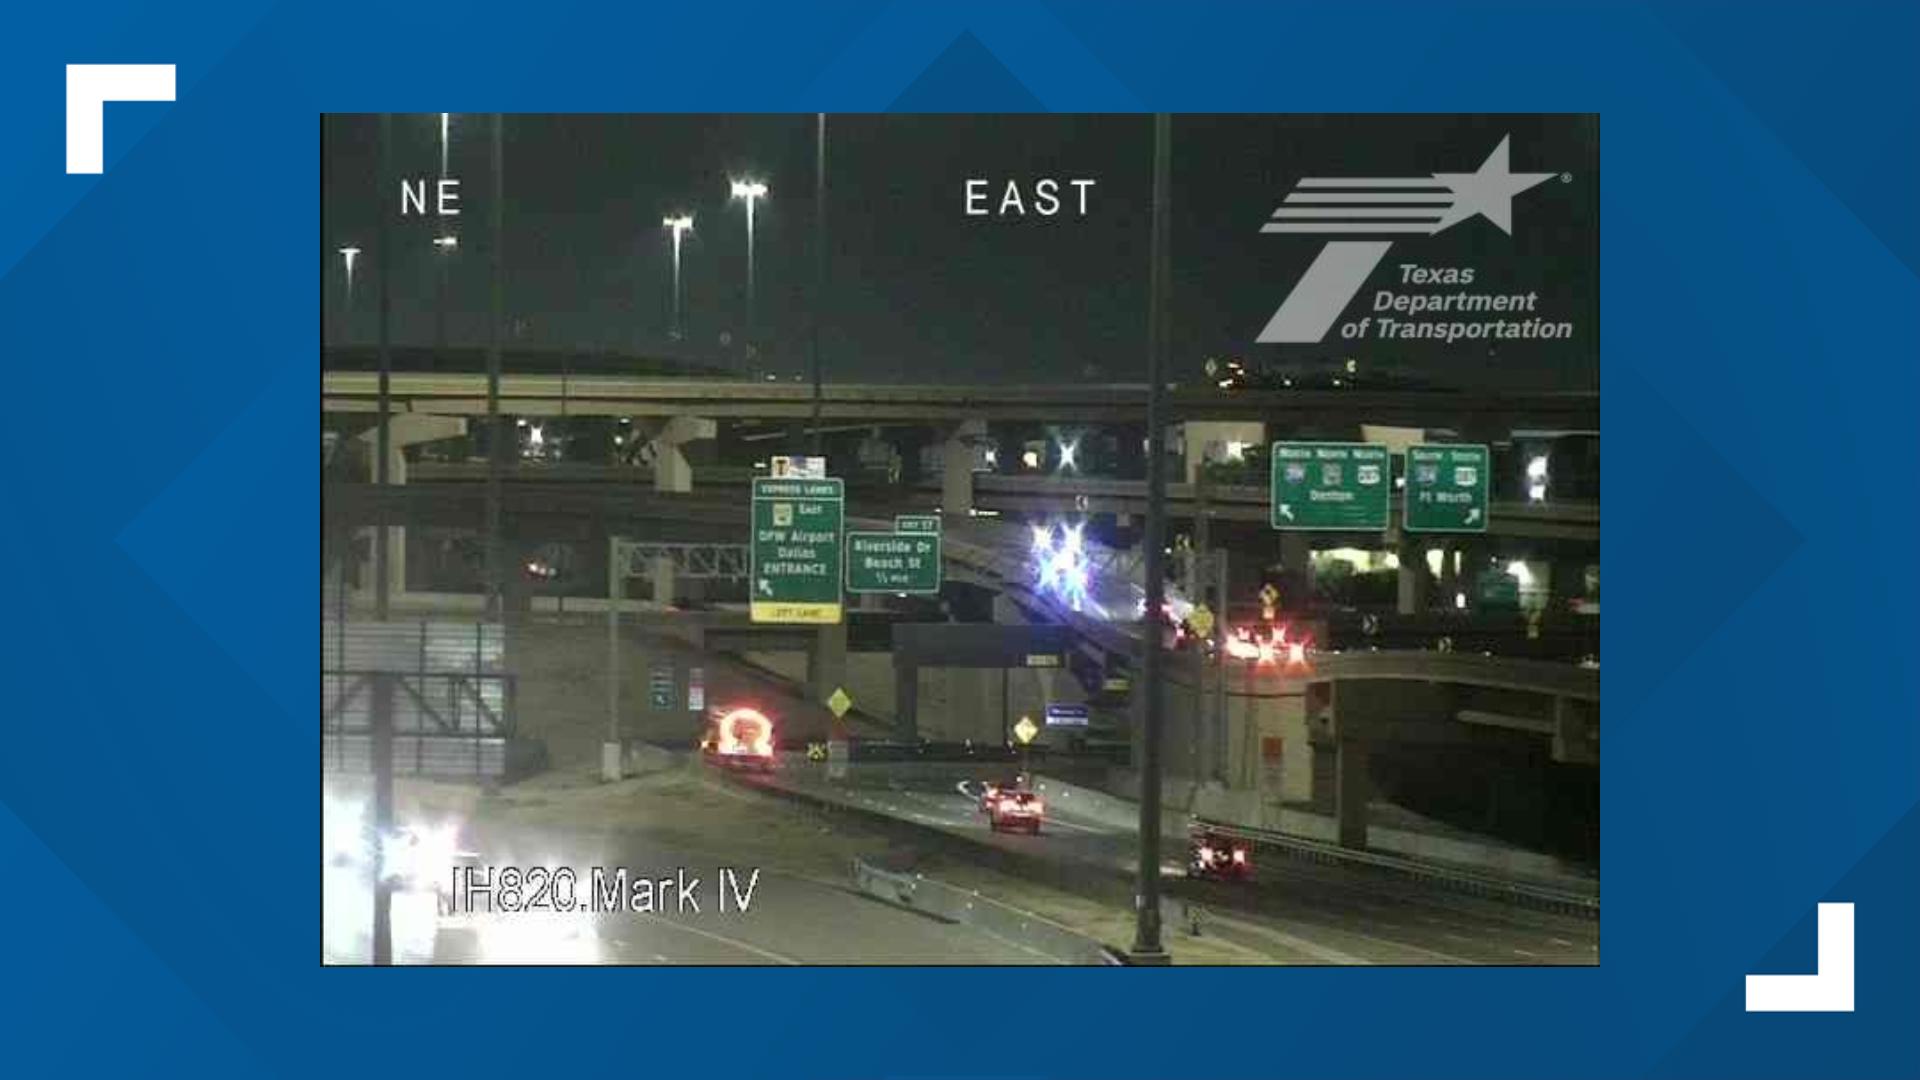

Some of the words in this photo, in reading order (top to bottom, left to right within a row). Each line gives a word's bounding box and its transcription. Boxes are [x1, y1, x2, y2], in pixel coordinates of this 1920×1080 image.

[791, 529, 835, 544] Airport
[778, 546, 817, 558] Dallas
[854, 540, 911, 553] Riverside
[763, 562, 827, 576] ENTRANCE
[864, 556, 902, 569] Beach
